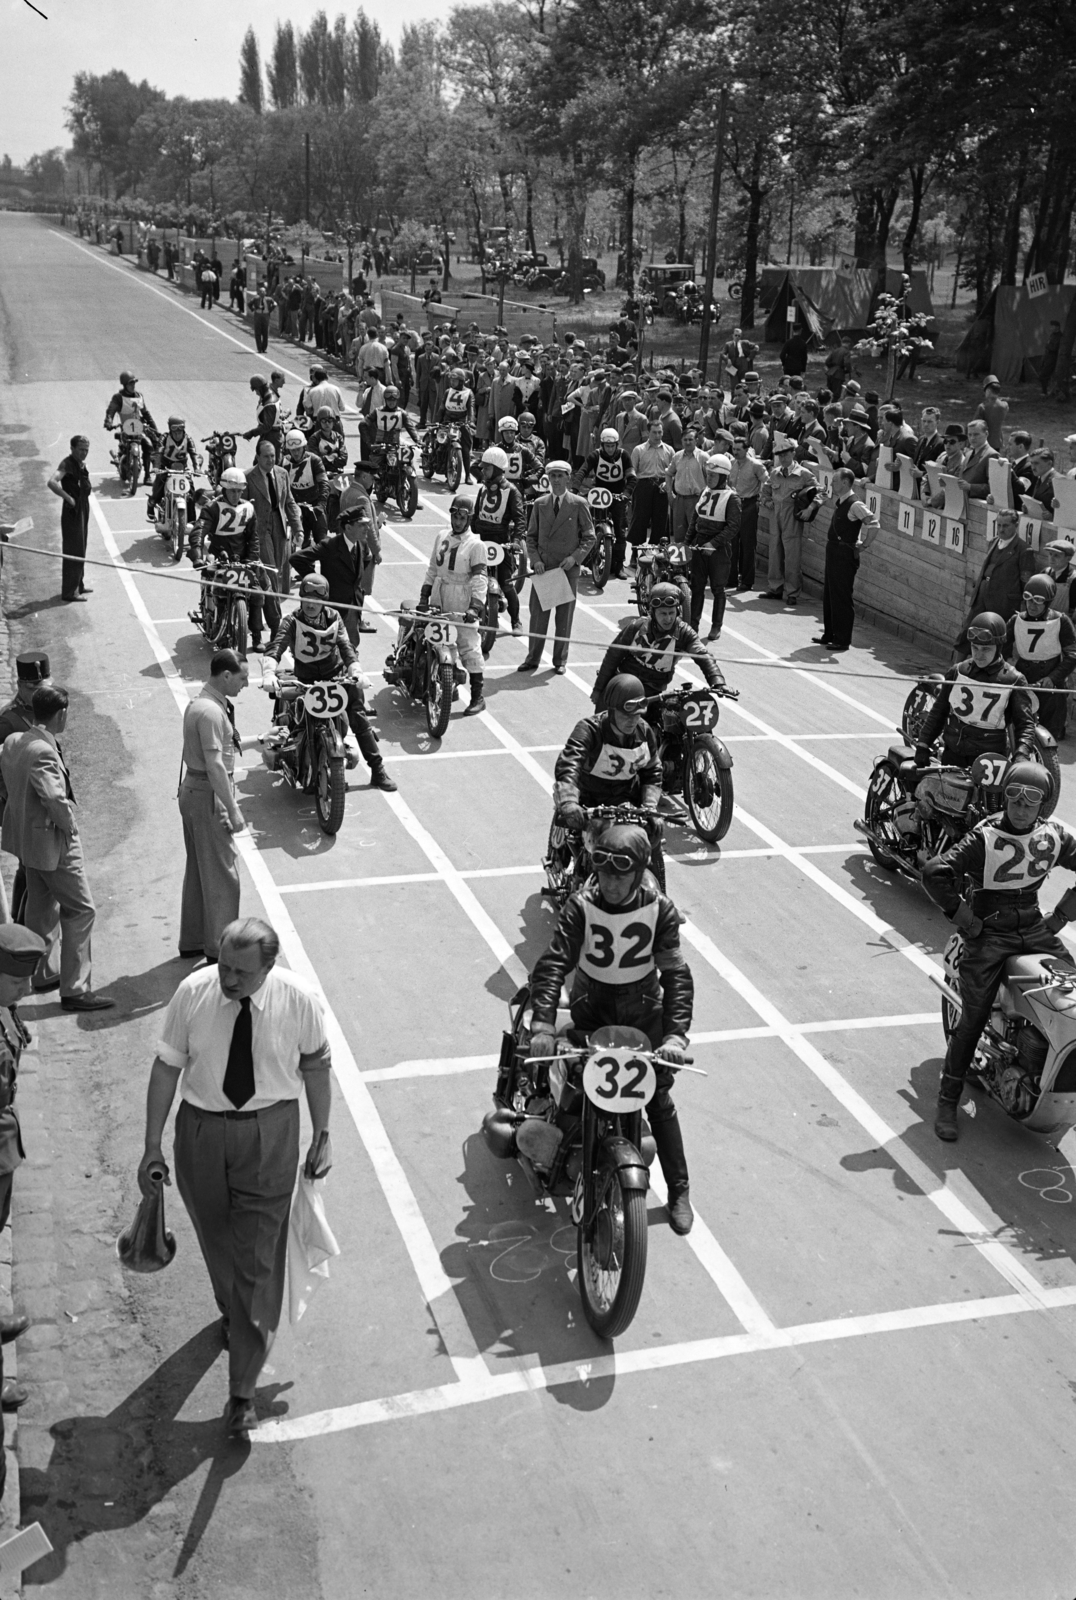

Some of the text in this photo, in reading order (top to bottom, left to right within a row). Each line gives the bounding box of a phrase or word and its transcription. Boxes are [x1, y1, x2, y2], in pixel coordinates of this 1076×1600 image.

[1030, 277, 1046, 294] HIR
[450, 391, 463, 407] 4
[129, 421, 134, 433] 1
[380, 414, 400, 431] 12
[222, 436, 234, 450] 9
[509, 457, 520, 474] 5
[599, 463, 622, 480] 20
[172, 479, 186, 491] 16
[590, 490, 611, 506] 20
[698, 491, 721, 517] 21
[219, 507, 249, 533] 24
[904, 510, 910, 529] 11
[928, 518, 936, 538] 12
[951, 527, 960, 547] 16
[1026, 522, 1034, 546] 19
[436, 540, 459, 571] 31
[668, 546, 687, 562] 21
[226, 570, 250, 588] 24
[430, 621, 450, 642] 31
[1027, 628, 1045, 653] 7
[301, 631, 336, 658] 35
[309, 685, 344, 714] 35
[913, 689, 924, 709] 7
[954, 686, 1001, 721] 37
[683, 700, 716, 727] 27
[871, 768, 891, 796] 37
[980, 758, 1007, 786] 37
[993, 835, 1056, 882] 28
[585, 921, 653, 969] 32
[944, 936, 964, 970] 28
[595, 1056, 648, 1099] 32
